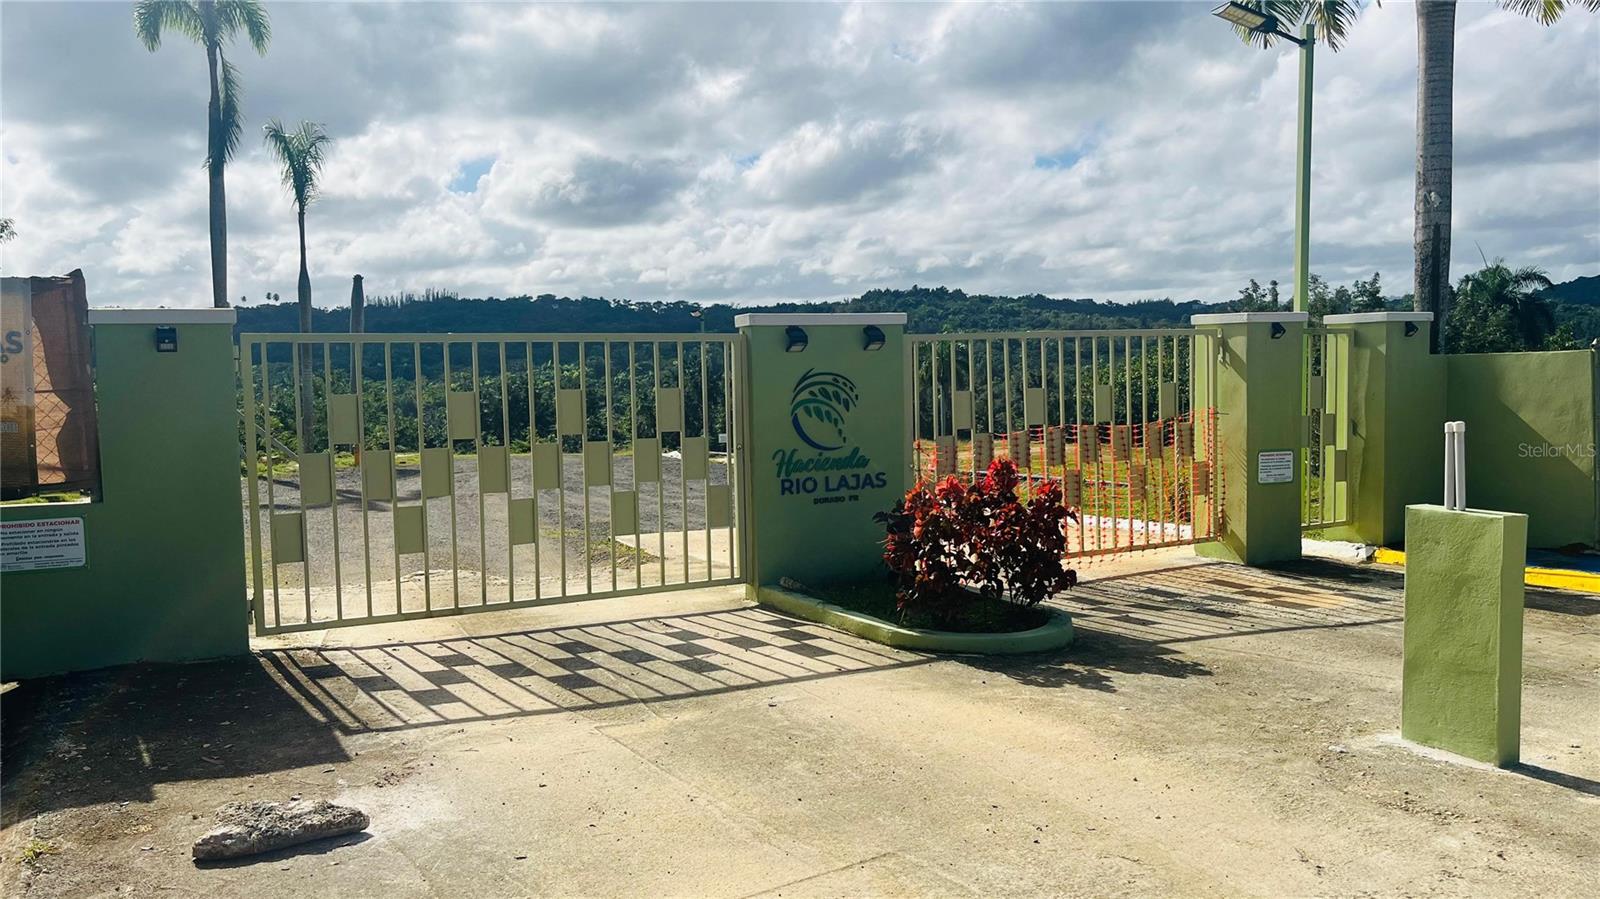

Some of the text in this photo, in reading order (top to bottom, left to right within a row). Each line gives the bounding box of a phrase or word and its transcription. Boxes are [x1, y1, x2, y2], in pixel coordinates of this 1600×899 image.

[772, 446, 871, 478] Hacienda
[780, 471, 887, 496] RIO LAJAS
[813, 495, 846, 505] DORADO
